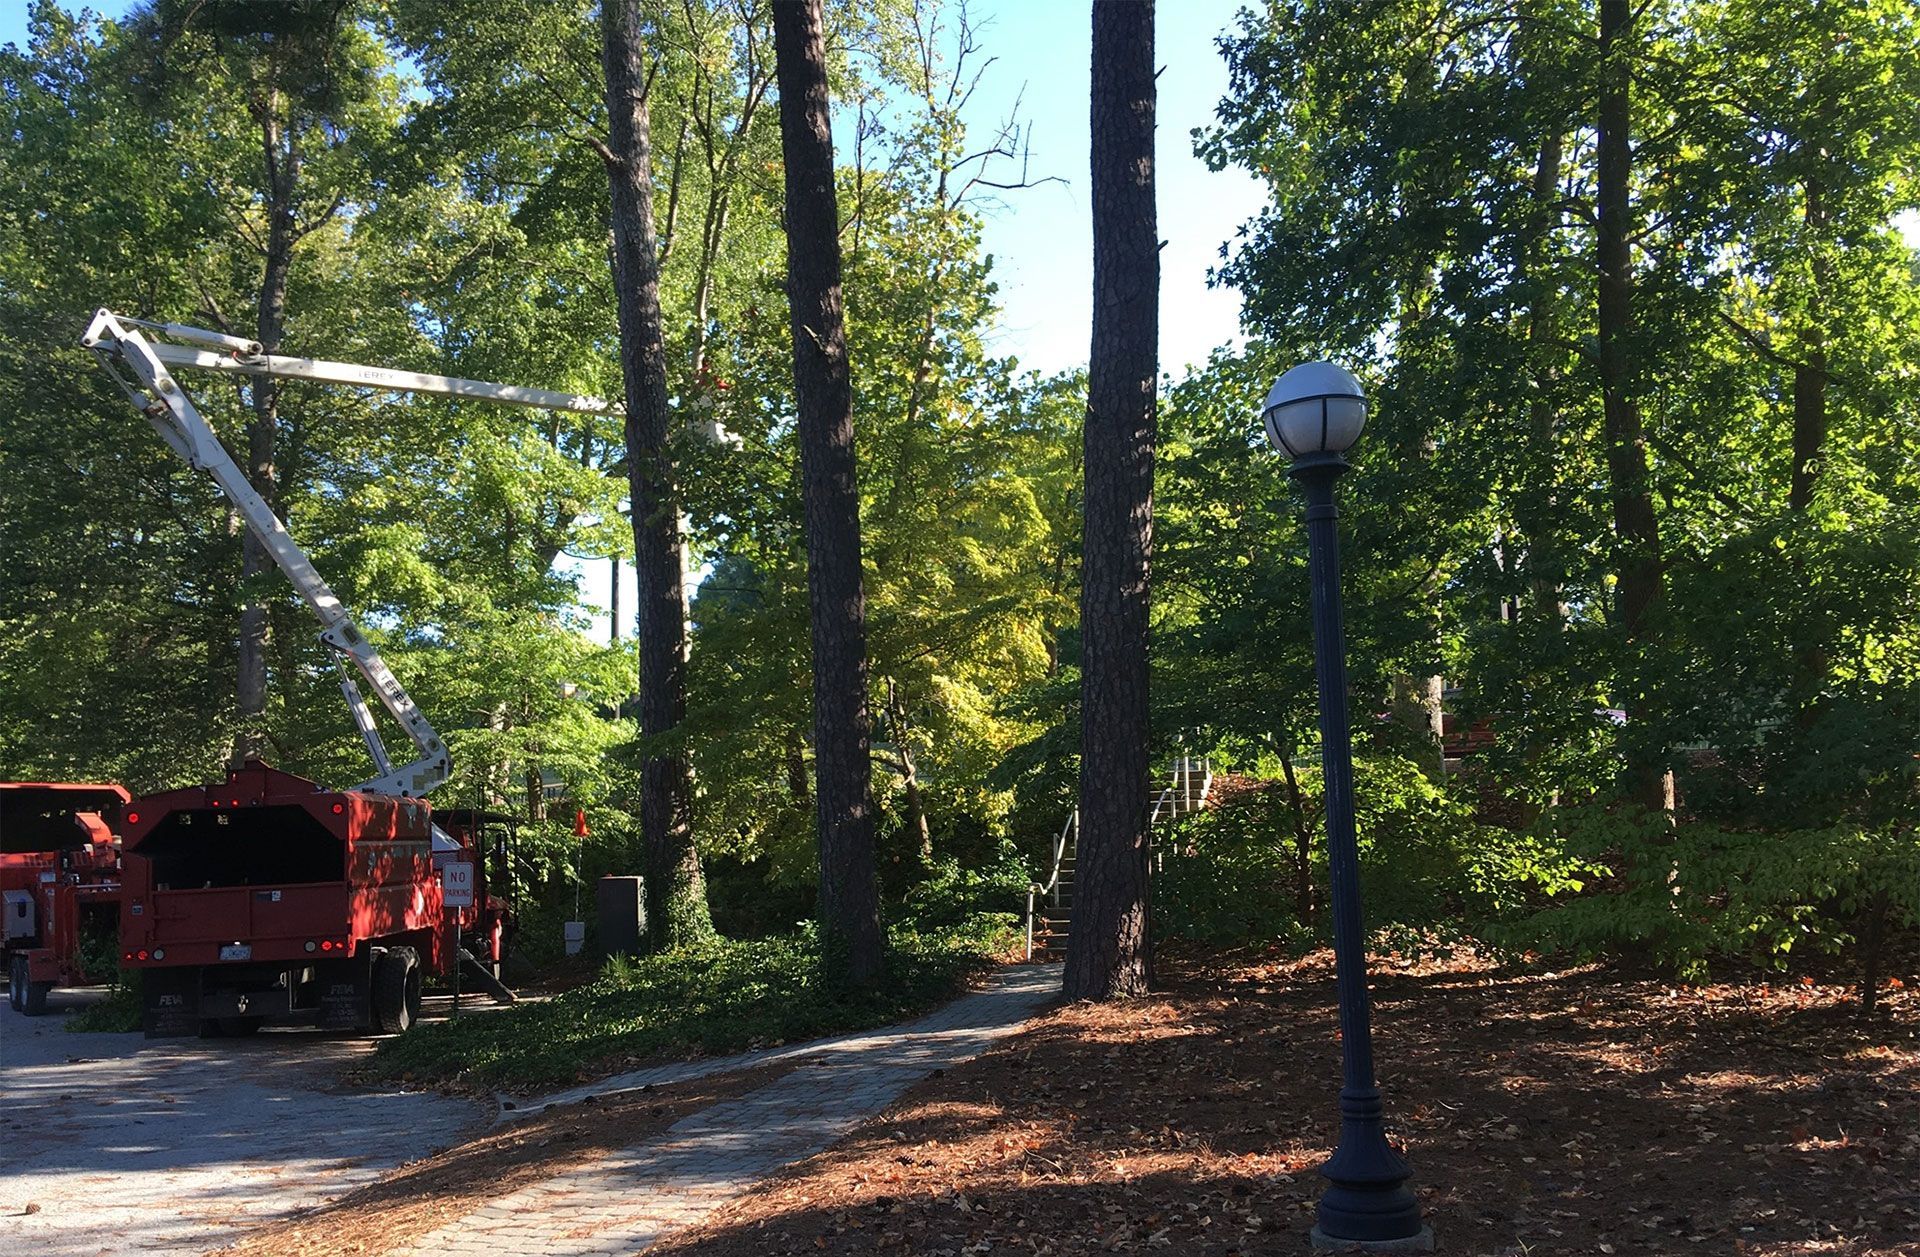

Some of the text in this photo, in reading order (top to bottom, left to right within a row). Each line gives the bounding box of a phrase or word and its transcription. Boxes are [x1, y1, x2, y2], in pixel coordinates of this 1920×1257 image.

[381, 675, 409, 708] TEREX
[450, 872, 465, 883] NO
[446, 888, 470, 897] PARKING
